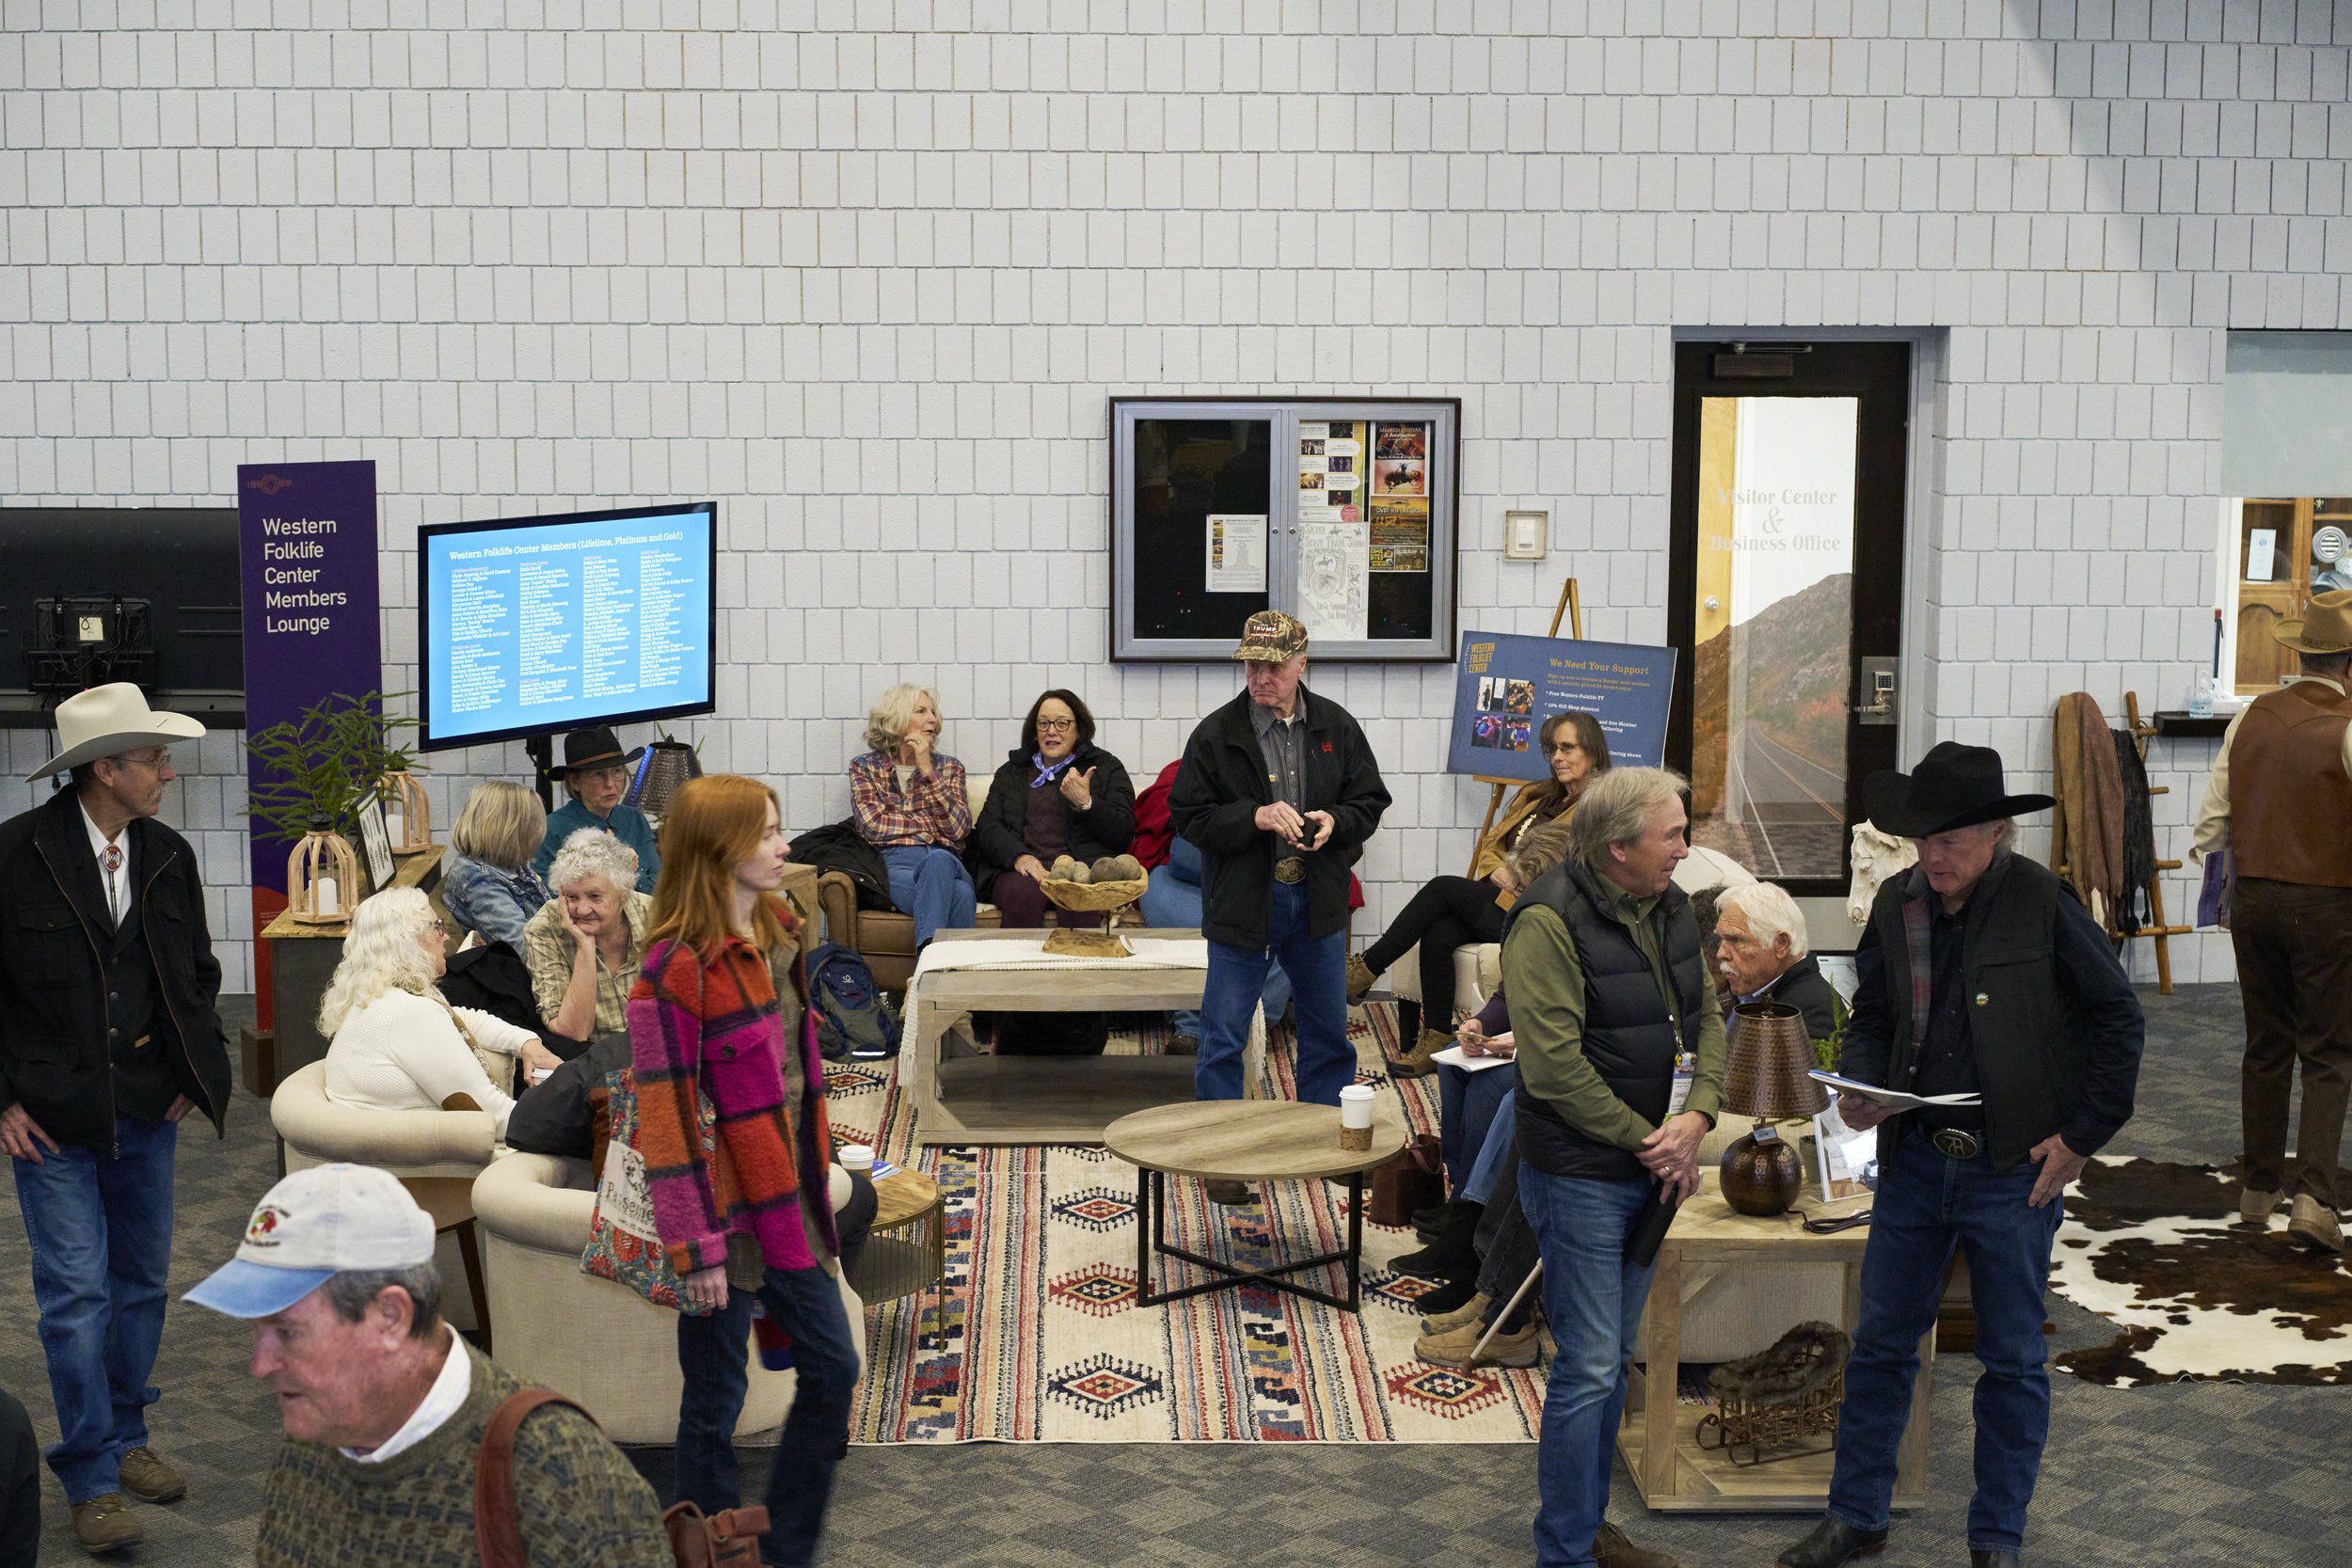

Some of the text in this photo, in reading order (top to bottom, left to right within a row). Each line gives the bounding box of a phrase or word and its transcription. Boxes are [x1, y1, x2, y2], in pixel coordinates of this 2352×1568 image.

[1718, 488, 1837, 505] Visitor Center
[262, 517, 337, 536] Western
[1762, 506, 1785, 534] &
[264, 541, 325, 560] Folklife
[450, 531, 683, 561] Western Folklife Center Members (Lifetime, Platinum and Gold)
[1709, 534, 1841, 552] Business Office
[265, 567, 321, 585] Center
[266, 590, 347, 609] Members
[267, 616, 330, 637] Lounge
[1470, 642, 1495, 654] WESTERN
[1470, 652, 1494, 663] FOLKLIFE
[1549, 658, 1649, 675] We Need Your Support
[1469, 663, 1487, 674] CENTER
